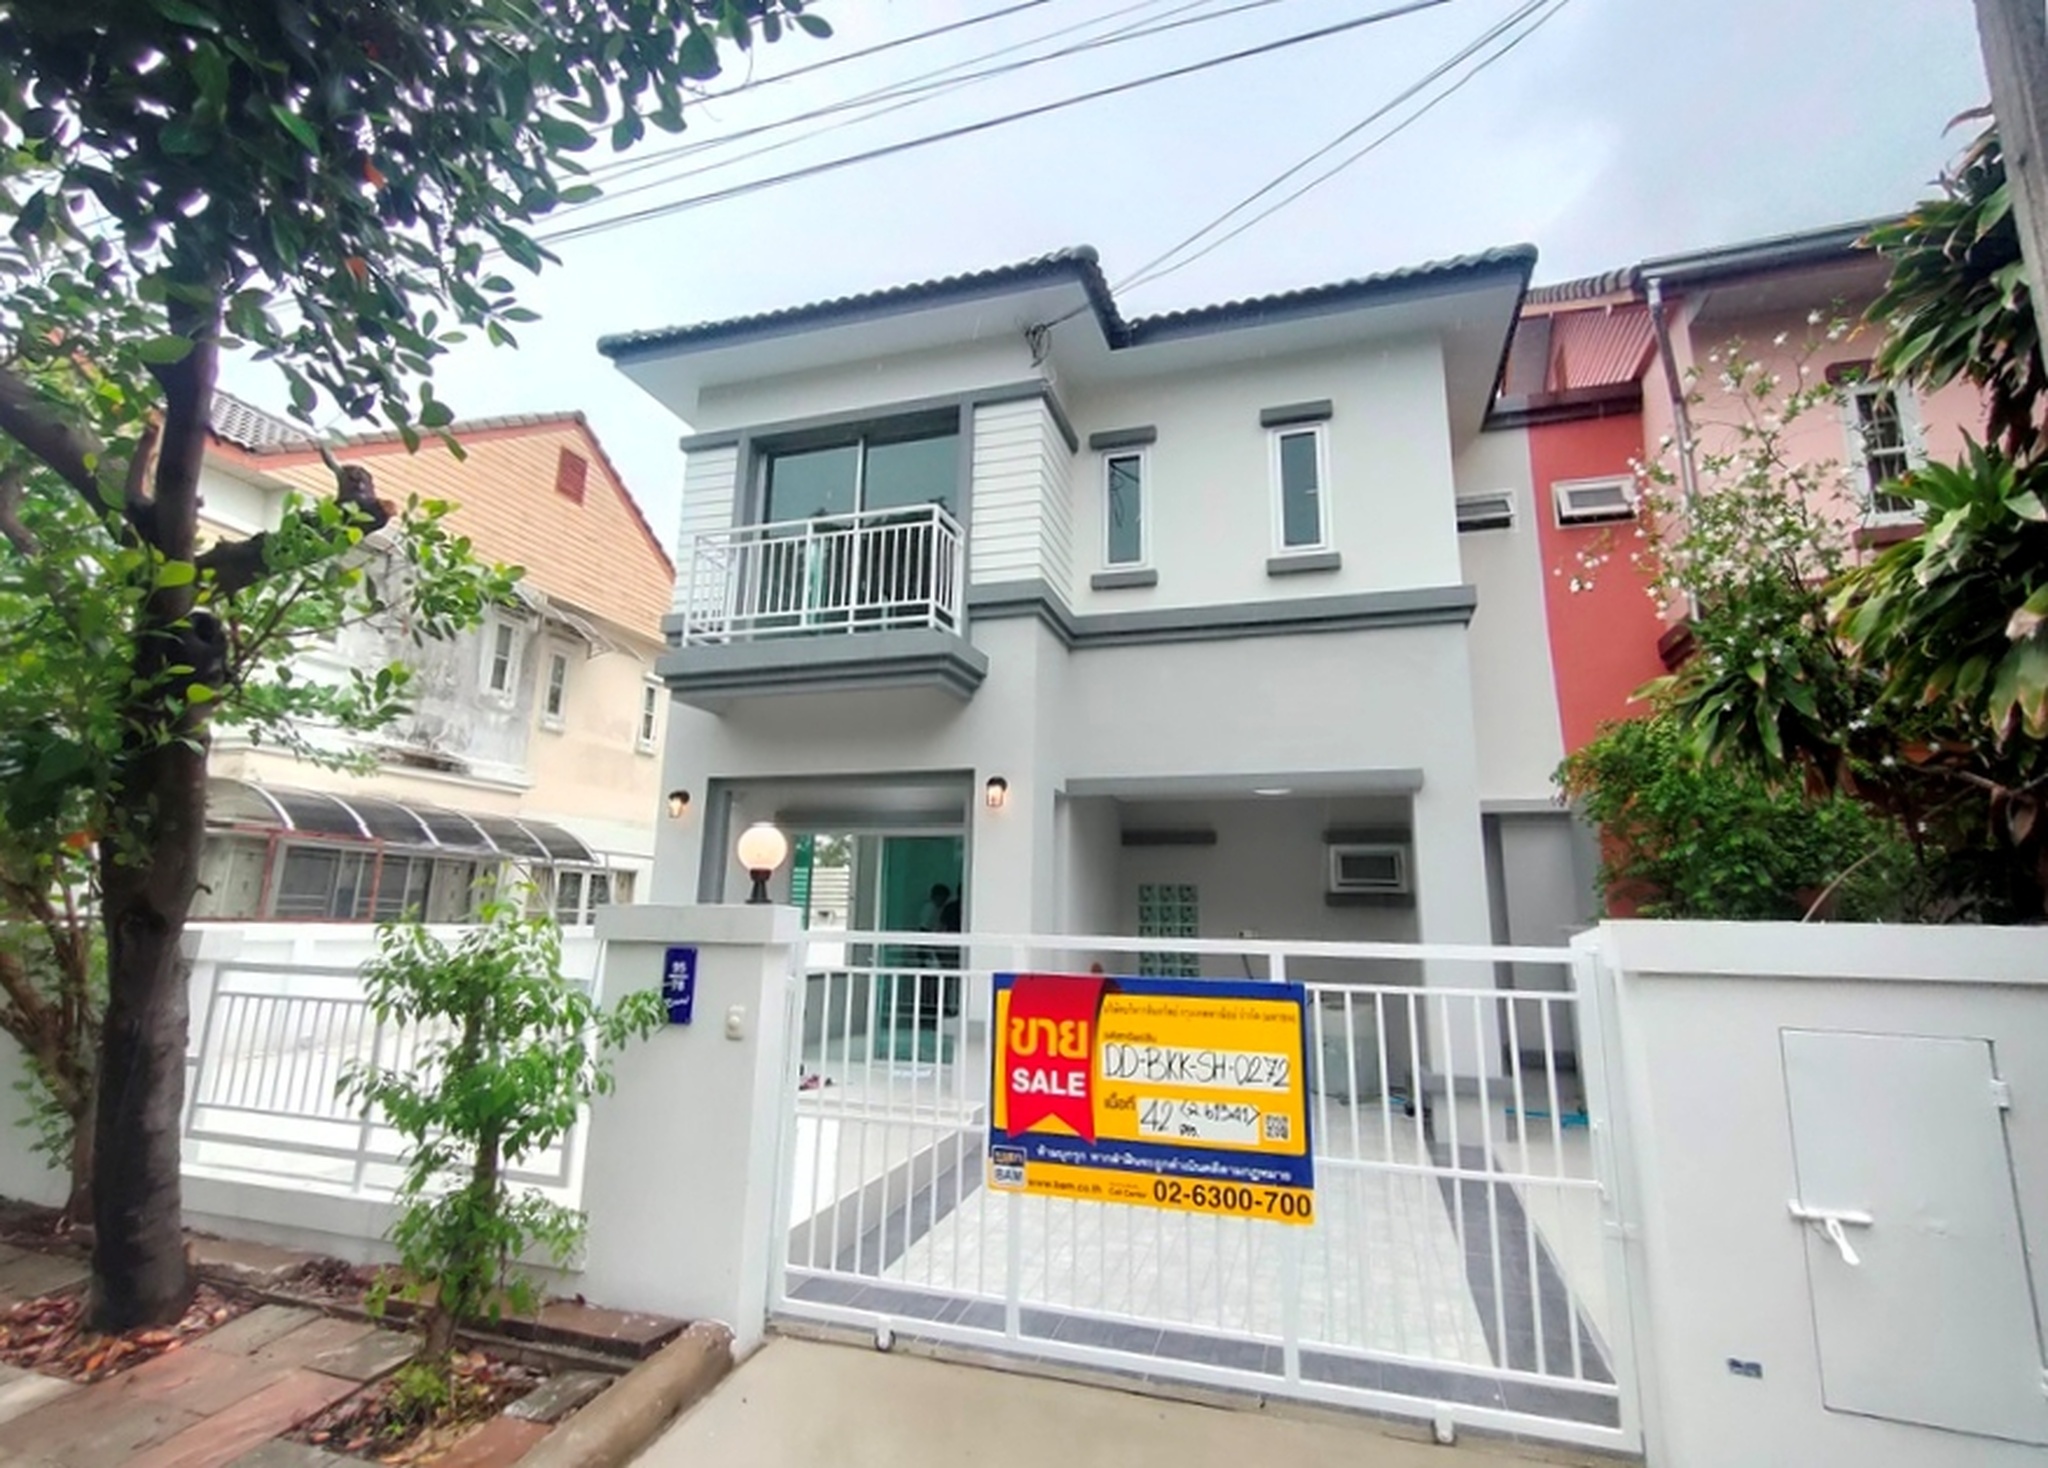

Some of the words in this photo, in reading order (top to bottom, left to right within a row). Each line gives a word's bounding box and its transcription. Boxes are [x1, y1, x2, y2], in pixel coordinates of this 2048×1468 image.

[1010, 1017, 1088, 1059] ขาย
[1012, 1067, 1086, 1097] SALE
[1140, 1099, 1174, 1132] 42
[995, 1167, 1023, 1182] BAM
[1153, 1179, 1312, 1217] 02-6300-700
